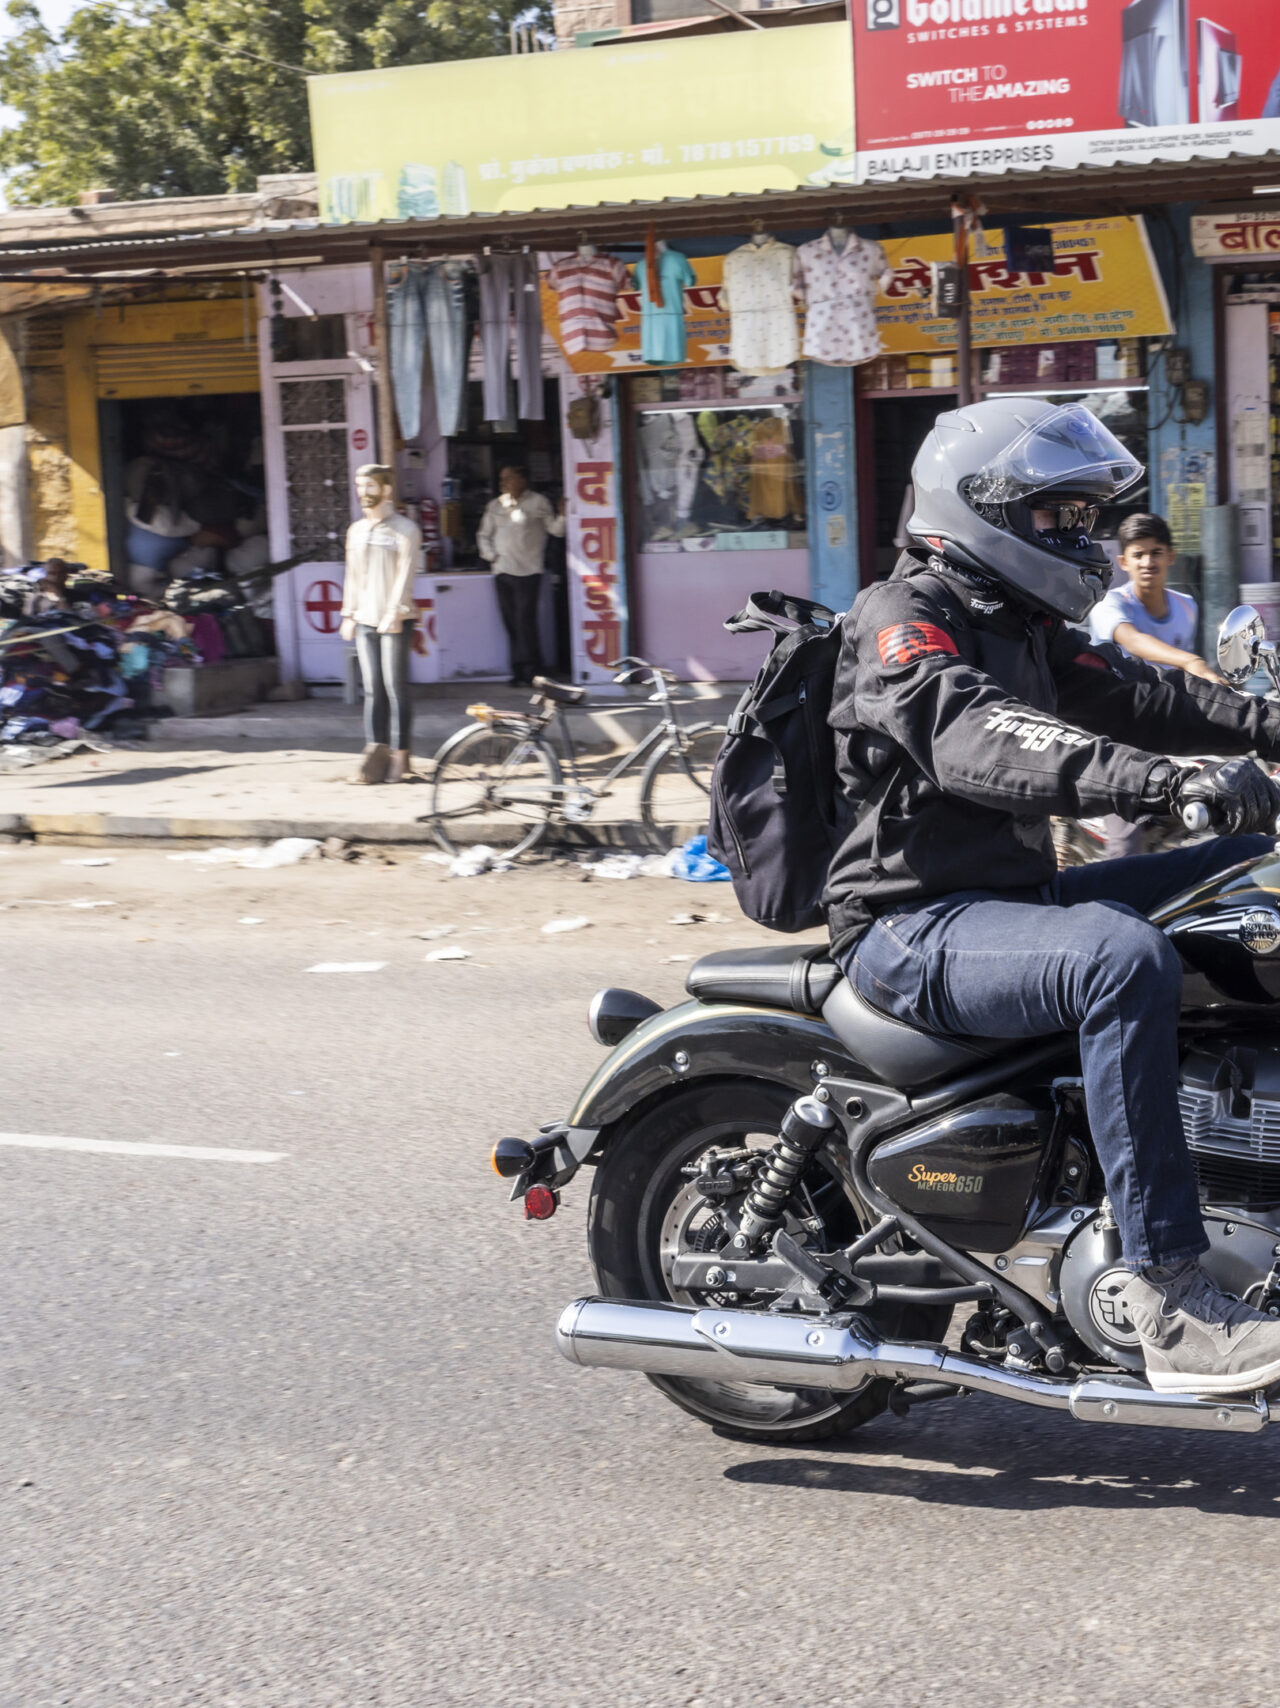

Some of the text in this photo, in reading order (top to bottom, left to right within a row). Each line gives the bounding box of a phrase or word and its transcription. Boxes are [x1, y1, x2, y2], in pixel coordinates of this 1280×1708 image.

[907, 15, 1088, 43] SWITCHES & SYSTEMS
[907, 64, 1007, 89] SWITCH TO
[948, 78, 1070, 103] THE AMAZING
[867, 145, 1054, 176] BALAJI ENTERPRISES
[908, 1164, 957, 1186] Super
[917, 1176, 983, 1193] METEOR 650
